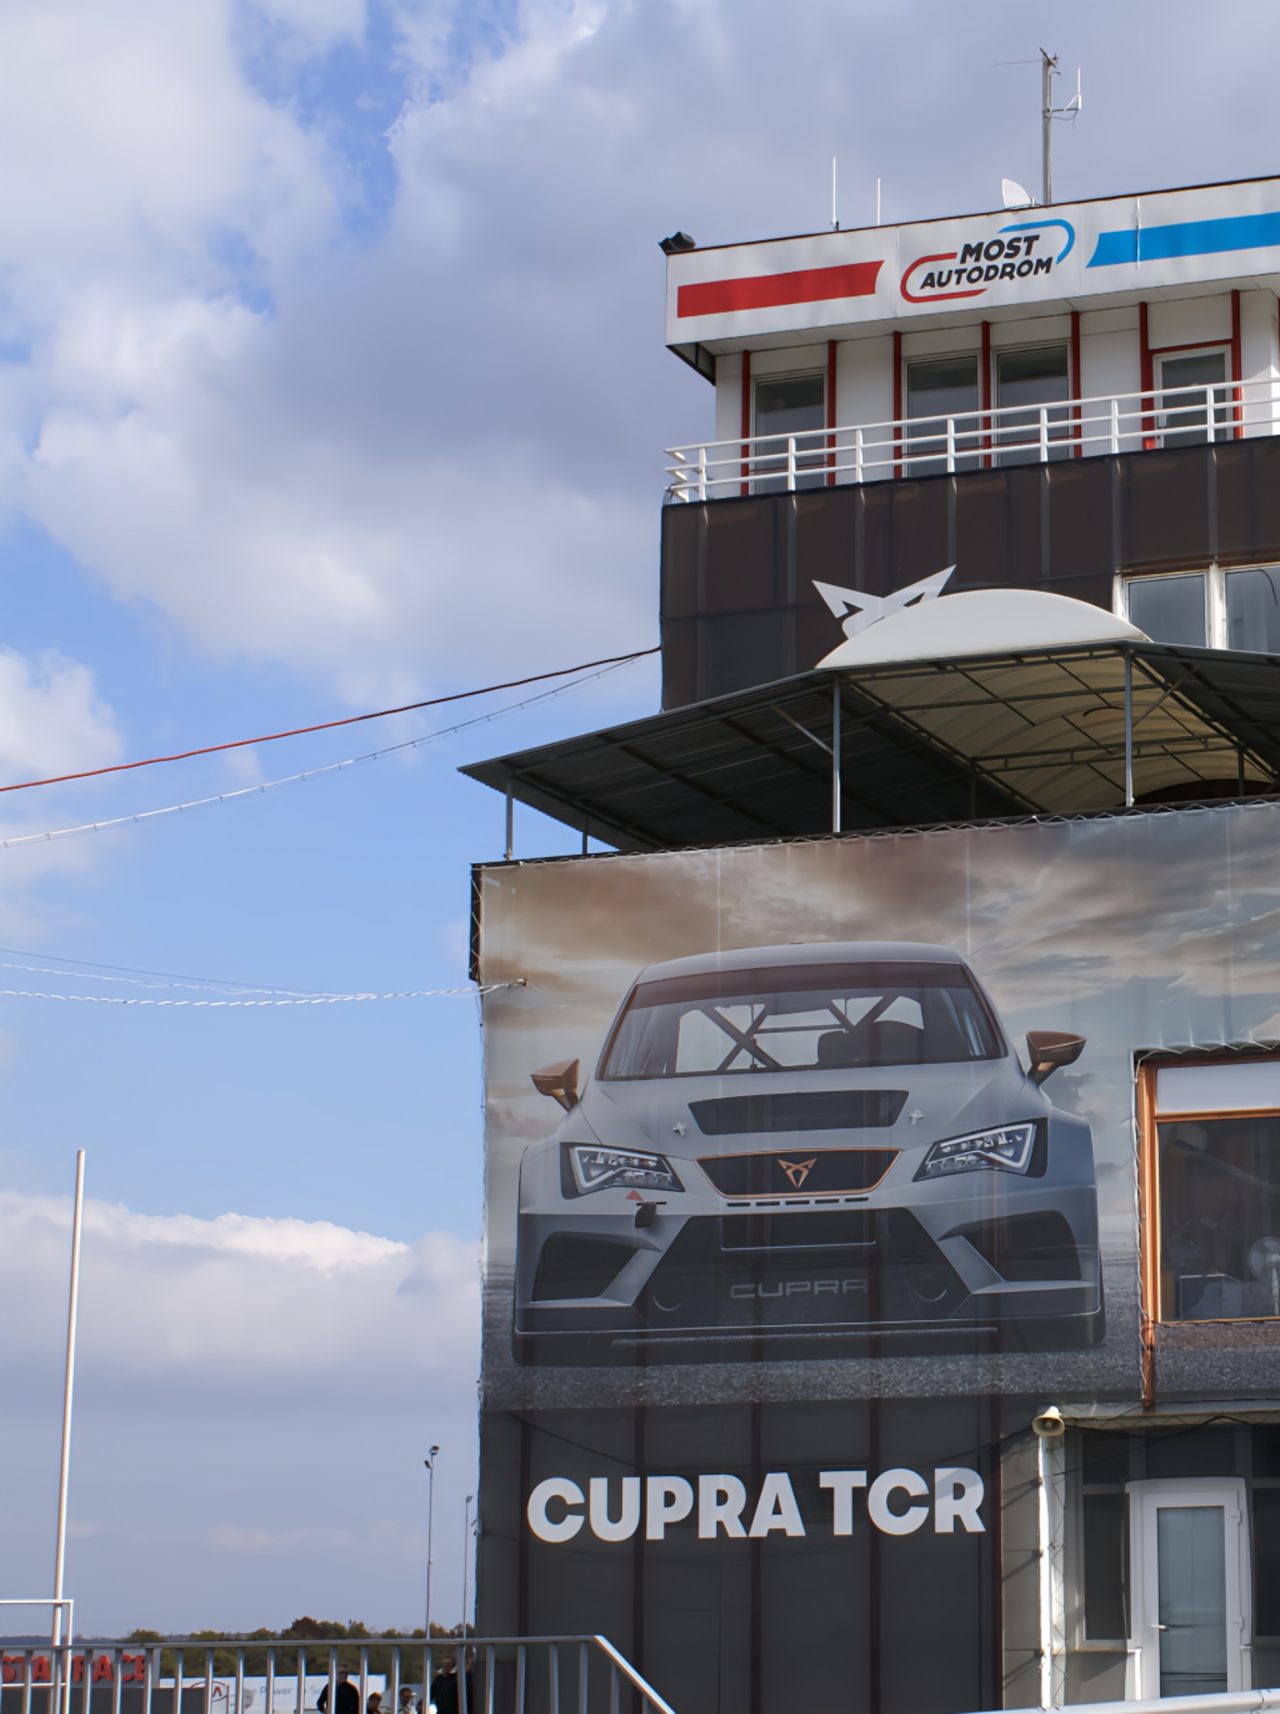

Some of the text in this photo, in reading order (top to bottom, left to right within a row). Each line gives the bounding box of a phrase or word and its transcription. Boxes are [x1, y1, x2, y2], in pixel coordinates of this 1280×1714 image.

[960, 235, 1040, 264] MOST
[920, 257, 1053, 289] AUTODROM
[730, 1278, 869, 1298] CUPRA
[527, 1467, 986, 1543] CUPRA TCR
[260, 1685, 293, 1695] Pwer
